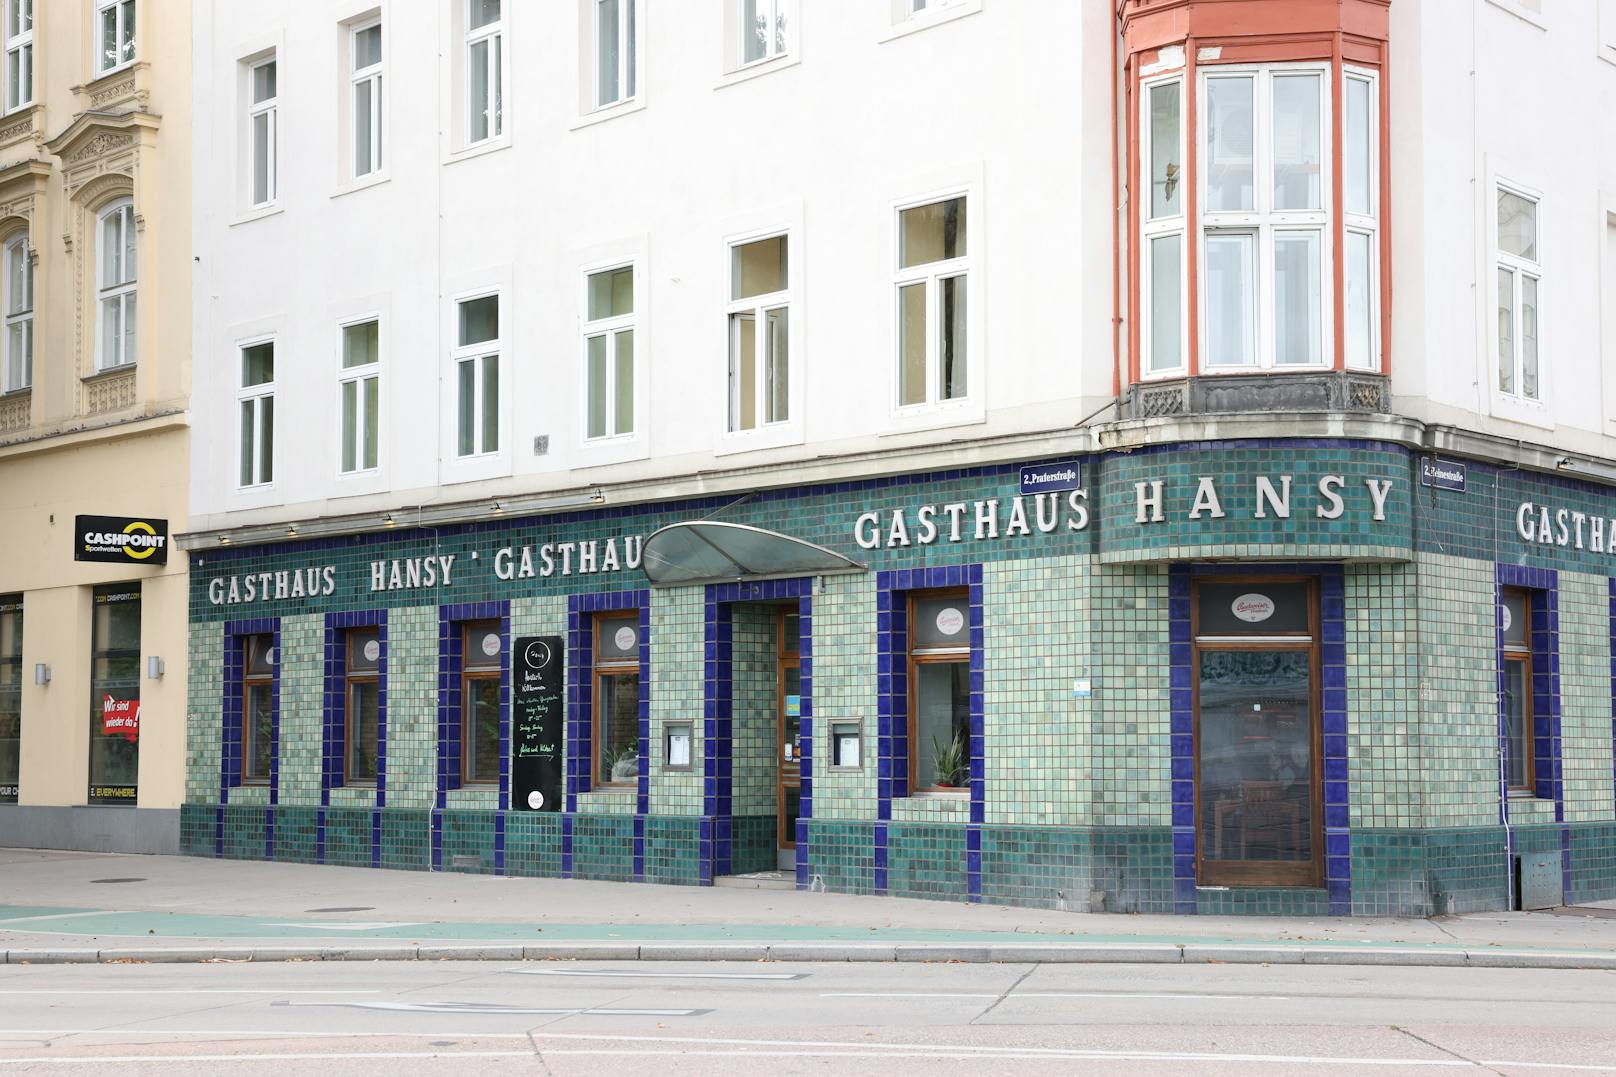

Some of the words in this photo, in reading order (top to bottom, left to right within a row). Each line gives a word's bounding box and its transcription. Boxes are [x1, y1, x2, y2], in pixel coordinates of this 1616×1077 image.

[1135, 475, 1393, 523] HANSY
[854, 489, 1089, 549] GASTHAUS
[84, 532, 165, 547] CASHPOINT
[85, 545, 122, 553] Sportwetten
[208, 566, 336, 605] GASTHAUS
[371, 555, 455, 592] HANSY
[116, 701, 129, 711] sind
[106, 717, 125, 728] wieder
